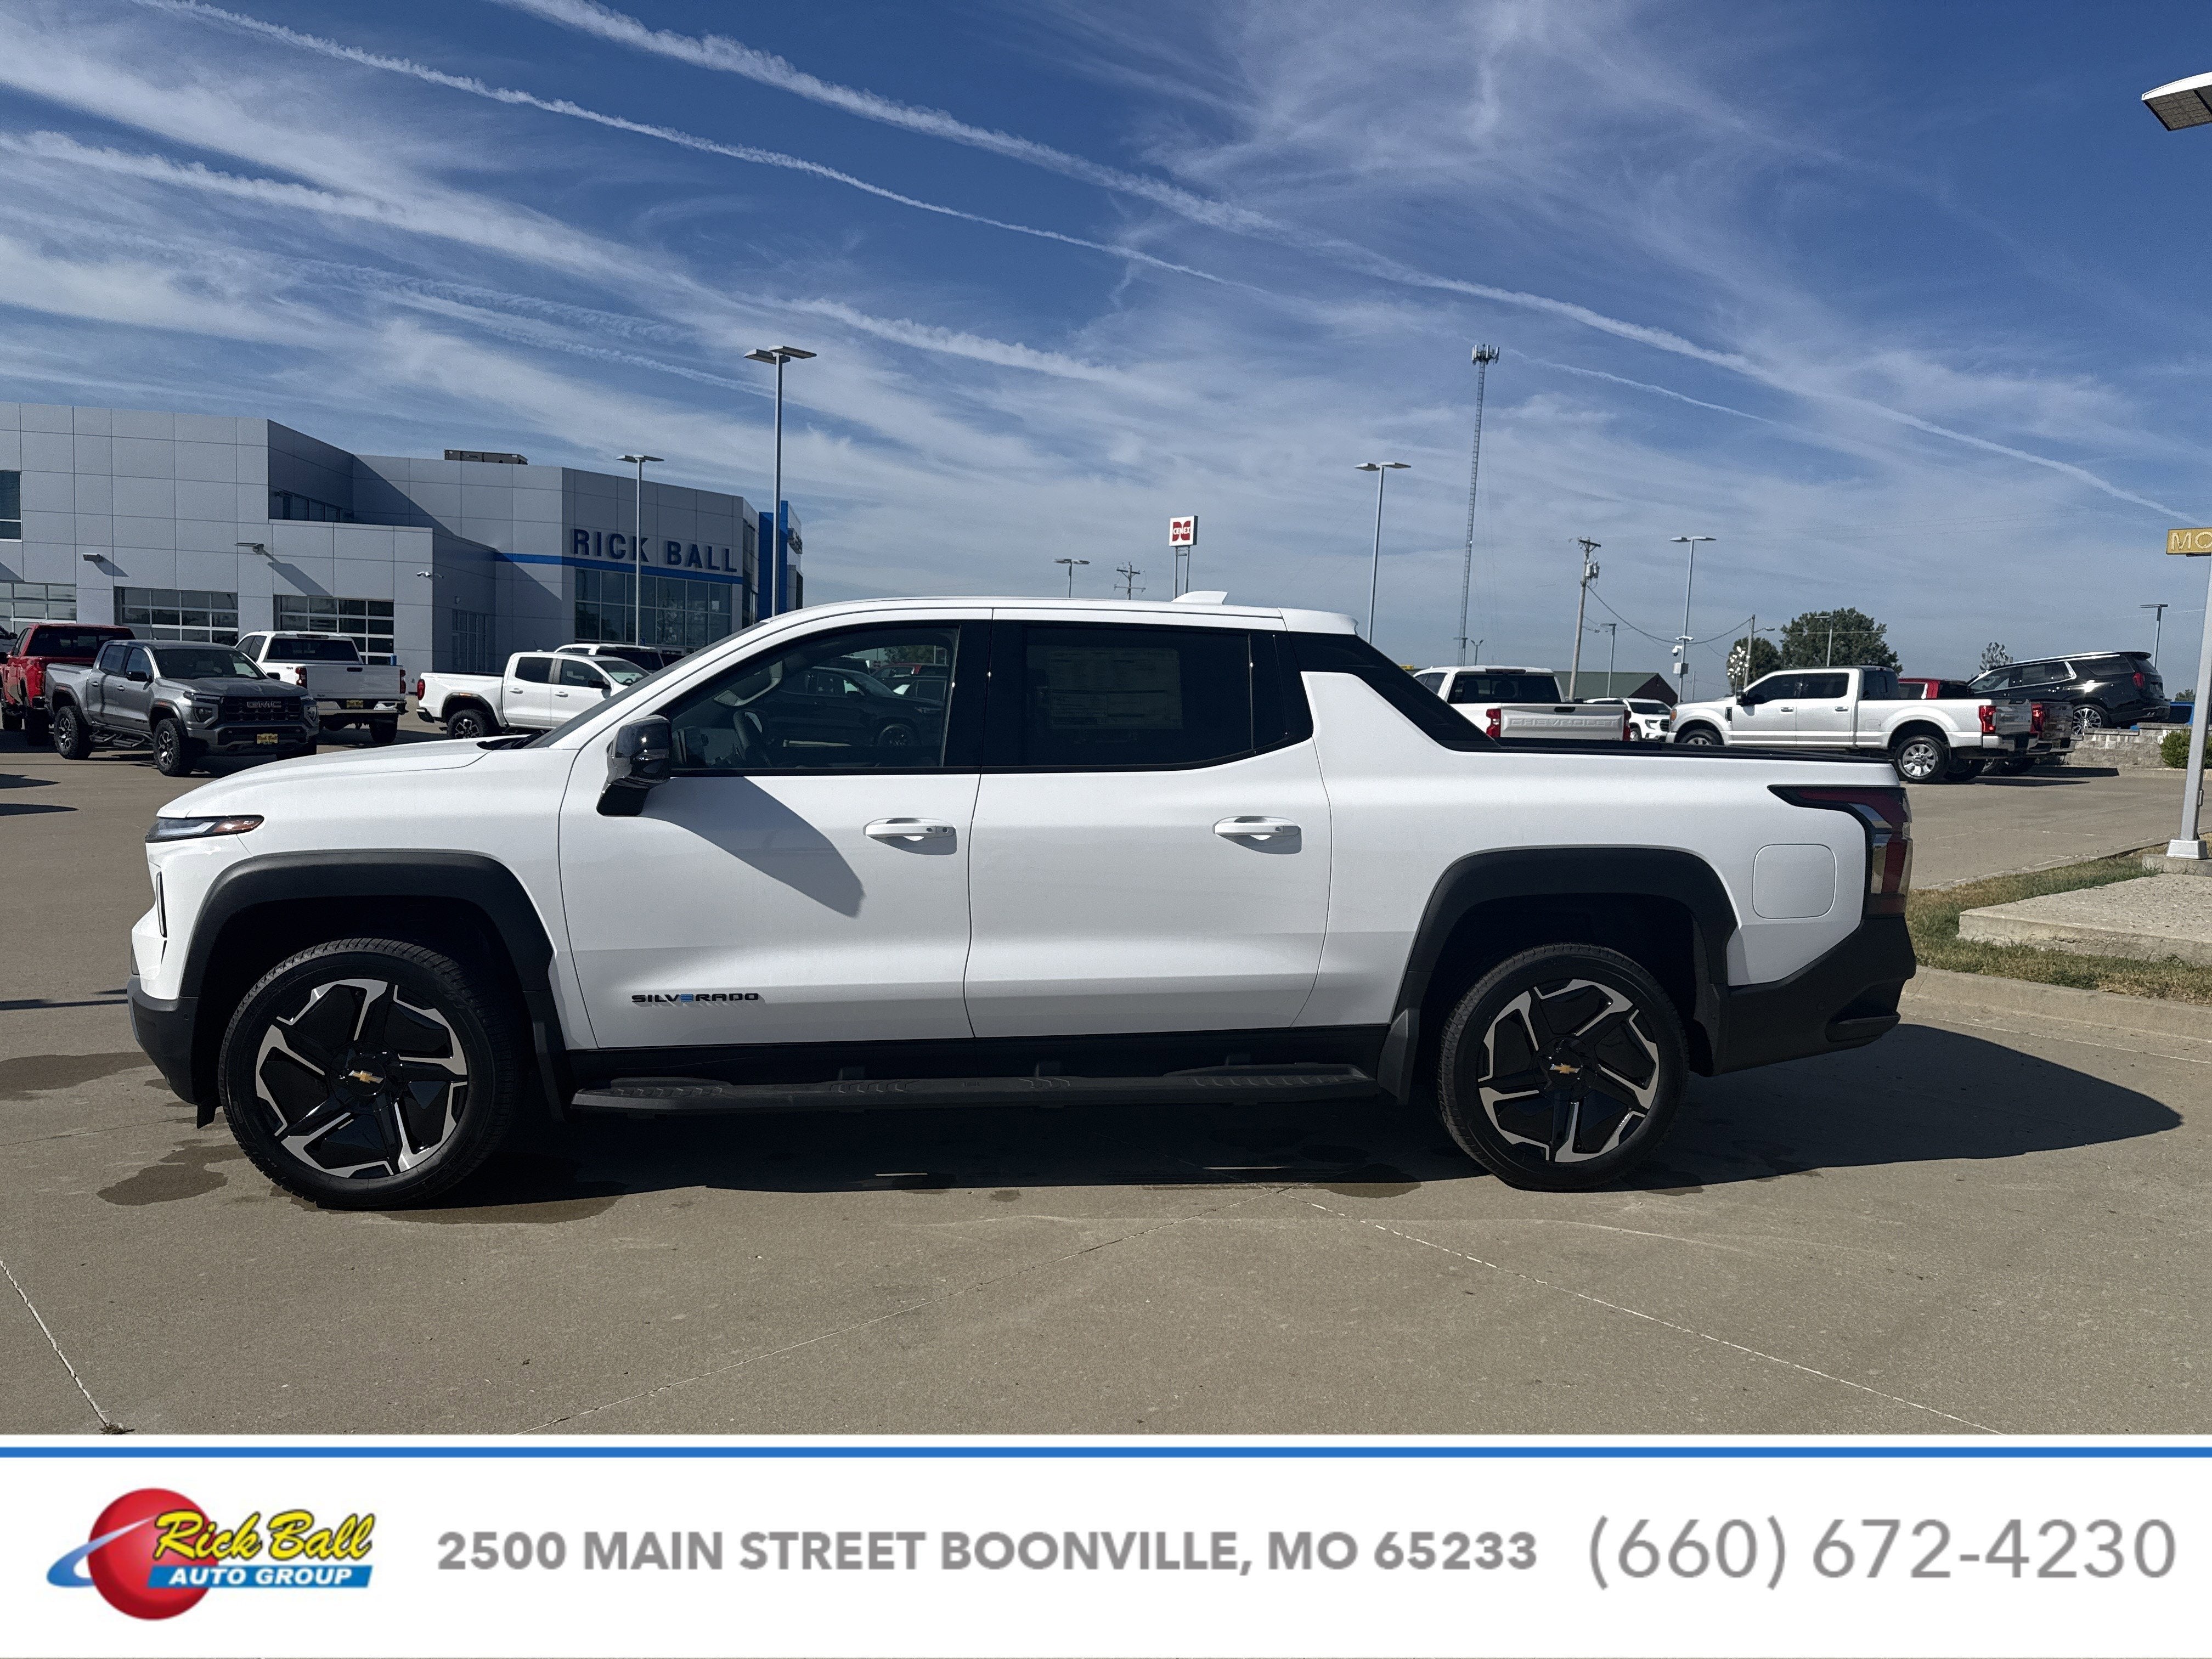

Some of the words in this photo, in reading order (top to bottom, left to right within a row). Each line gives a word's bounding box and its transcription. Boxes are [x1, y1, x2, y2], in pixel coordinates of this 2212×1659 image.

[573, 529, 649, 563] RICK
[667, 540, 738, 573] BALL
[1510, 718, 1618, 727] CHEVROLET
[631, 993, 759, 1003] SILVERADO
